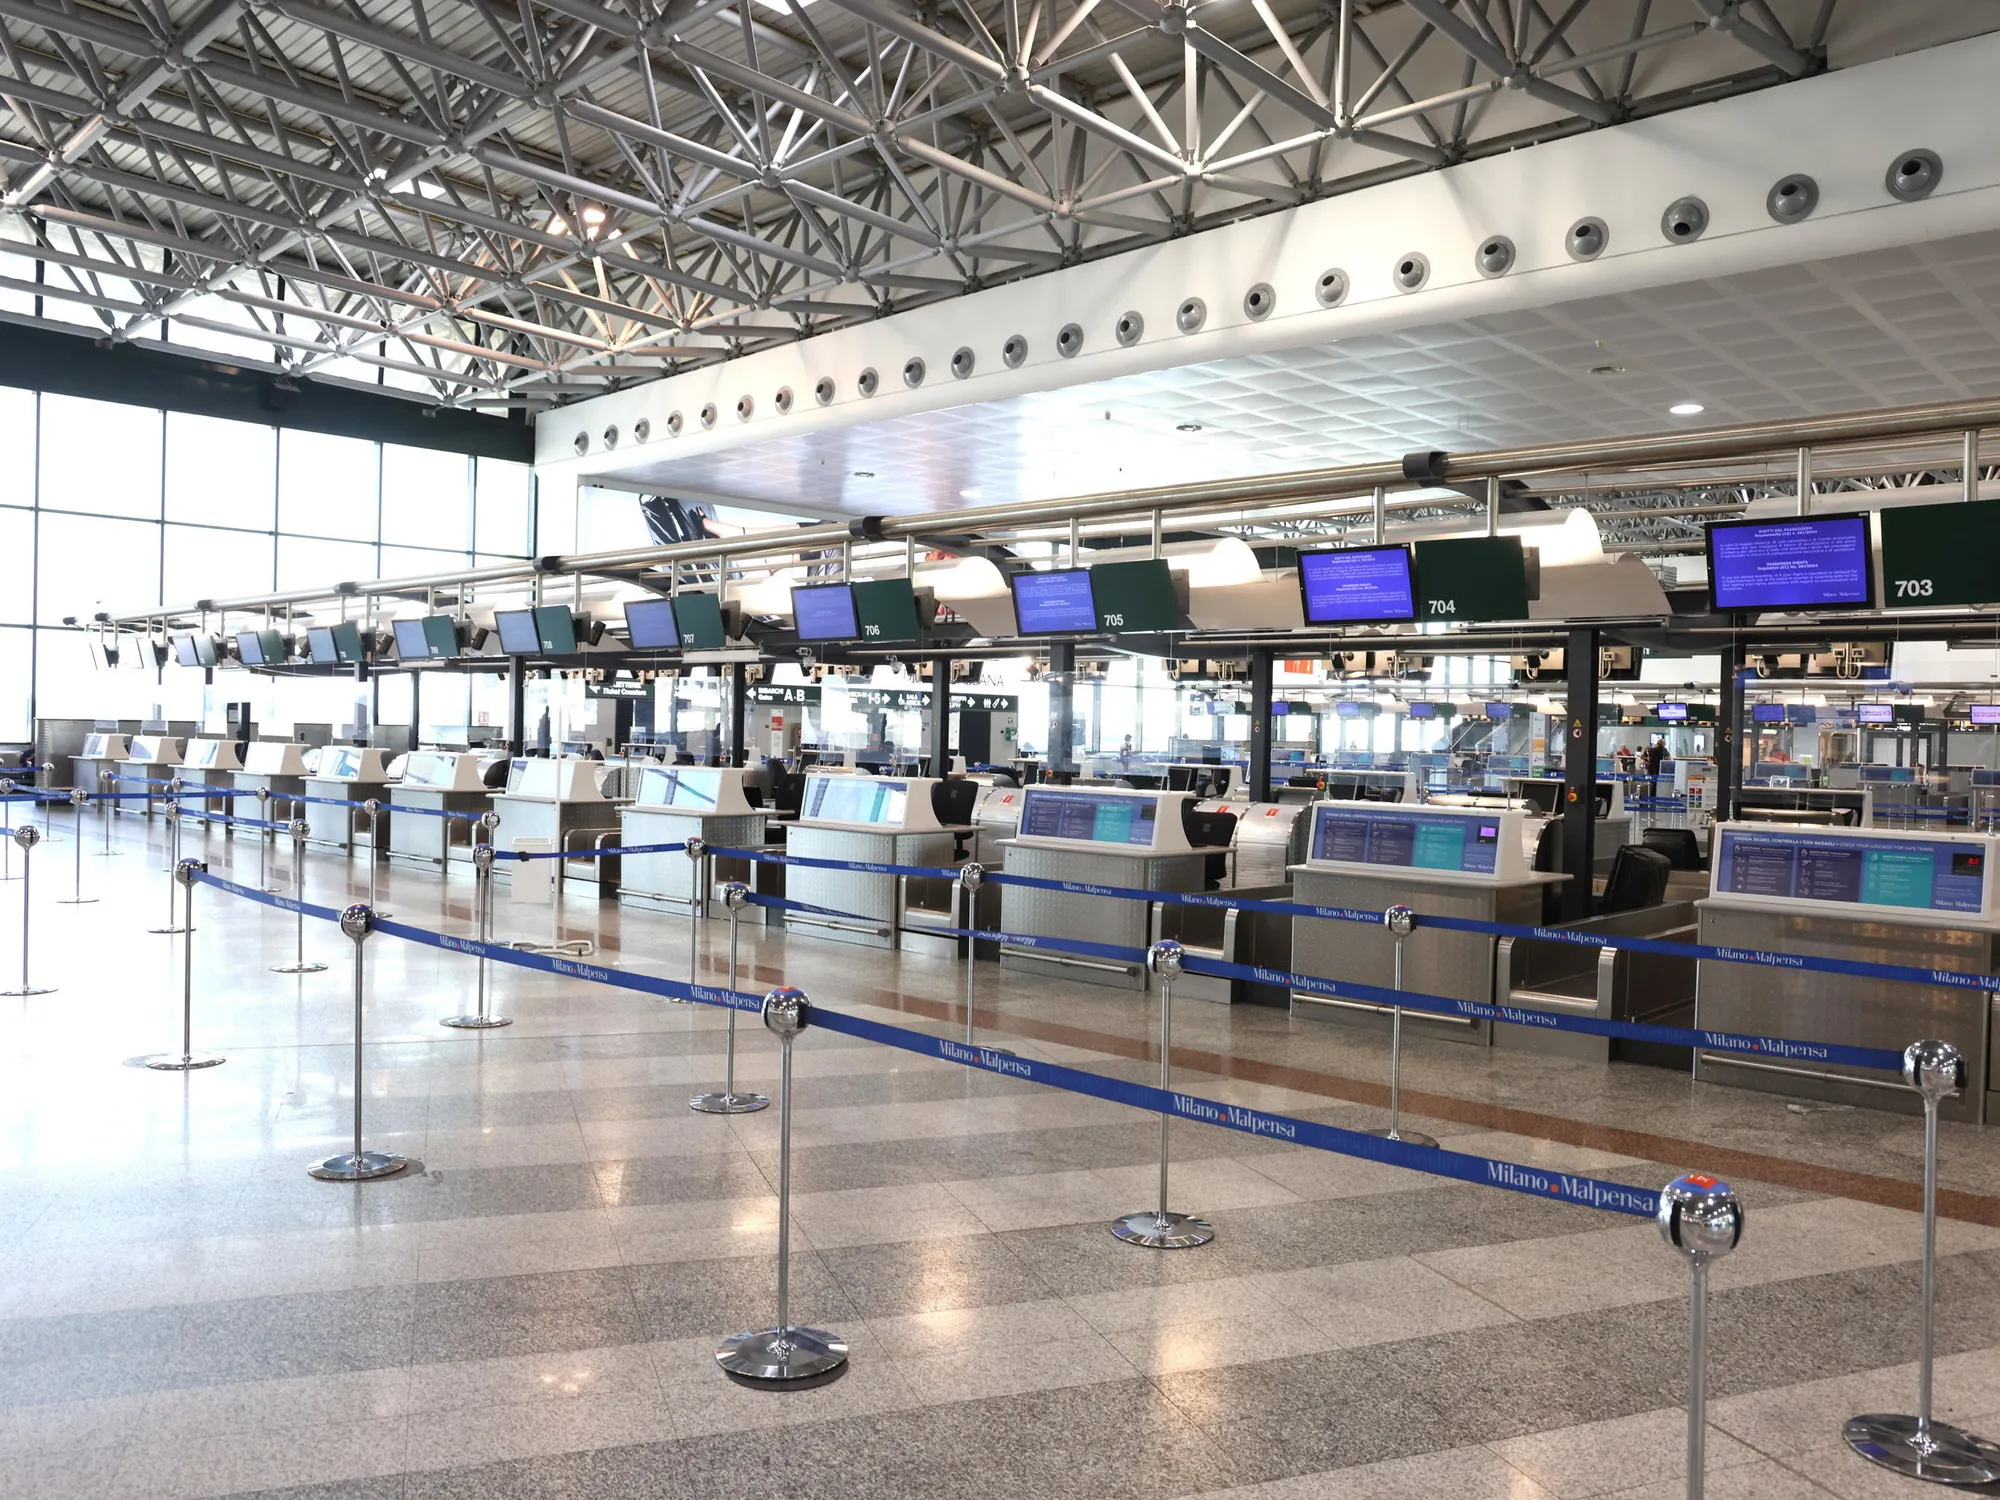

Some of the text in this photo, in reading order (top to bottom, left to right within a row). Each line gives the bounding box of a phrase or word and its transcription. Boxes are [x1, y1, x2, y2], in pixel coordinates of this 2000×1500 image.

[1895, 579, 1933, 597] 703
[1429, 600, 1456, 614] 704
[1104, 614, 1124, 626] 705
[683, 634, 694, 643] 707
[865, 625, 880, 635] 706
[1062, 882, 1112, 895] Milano Malpensa
[1181, 894, 1237, 908] Milano Malpensa
[1316, 906, 1378, 921] Milano Malpensa
[439, 934, 486, 954] Milano Malpensa
[1533, 927, 1607, 945] Milano Malpensa
[1716, 947, 1803, 966] Milano Malpensa
[552, 959, 608, 980] Milano Malpensa
[1932, 971, 1970, 985] Milano
[1253, 968, 1336, 992] Milano Malpensa
[691, 986, 760, 1009] Milano Malpensa
[1457, 1000, 1557, 1026] Milano Malpensa
[1705, 1032, 1828, 1058] Milano Malpensa
[939, 1040, 1031, 1076] Milano Malpensa
[1173, 1094, 1295, 1137] Milano Malpensa
[1487, 1161, 1653, 1212] Milano Malpensa
